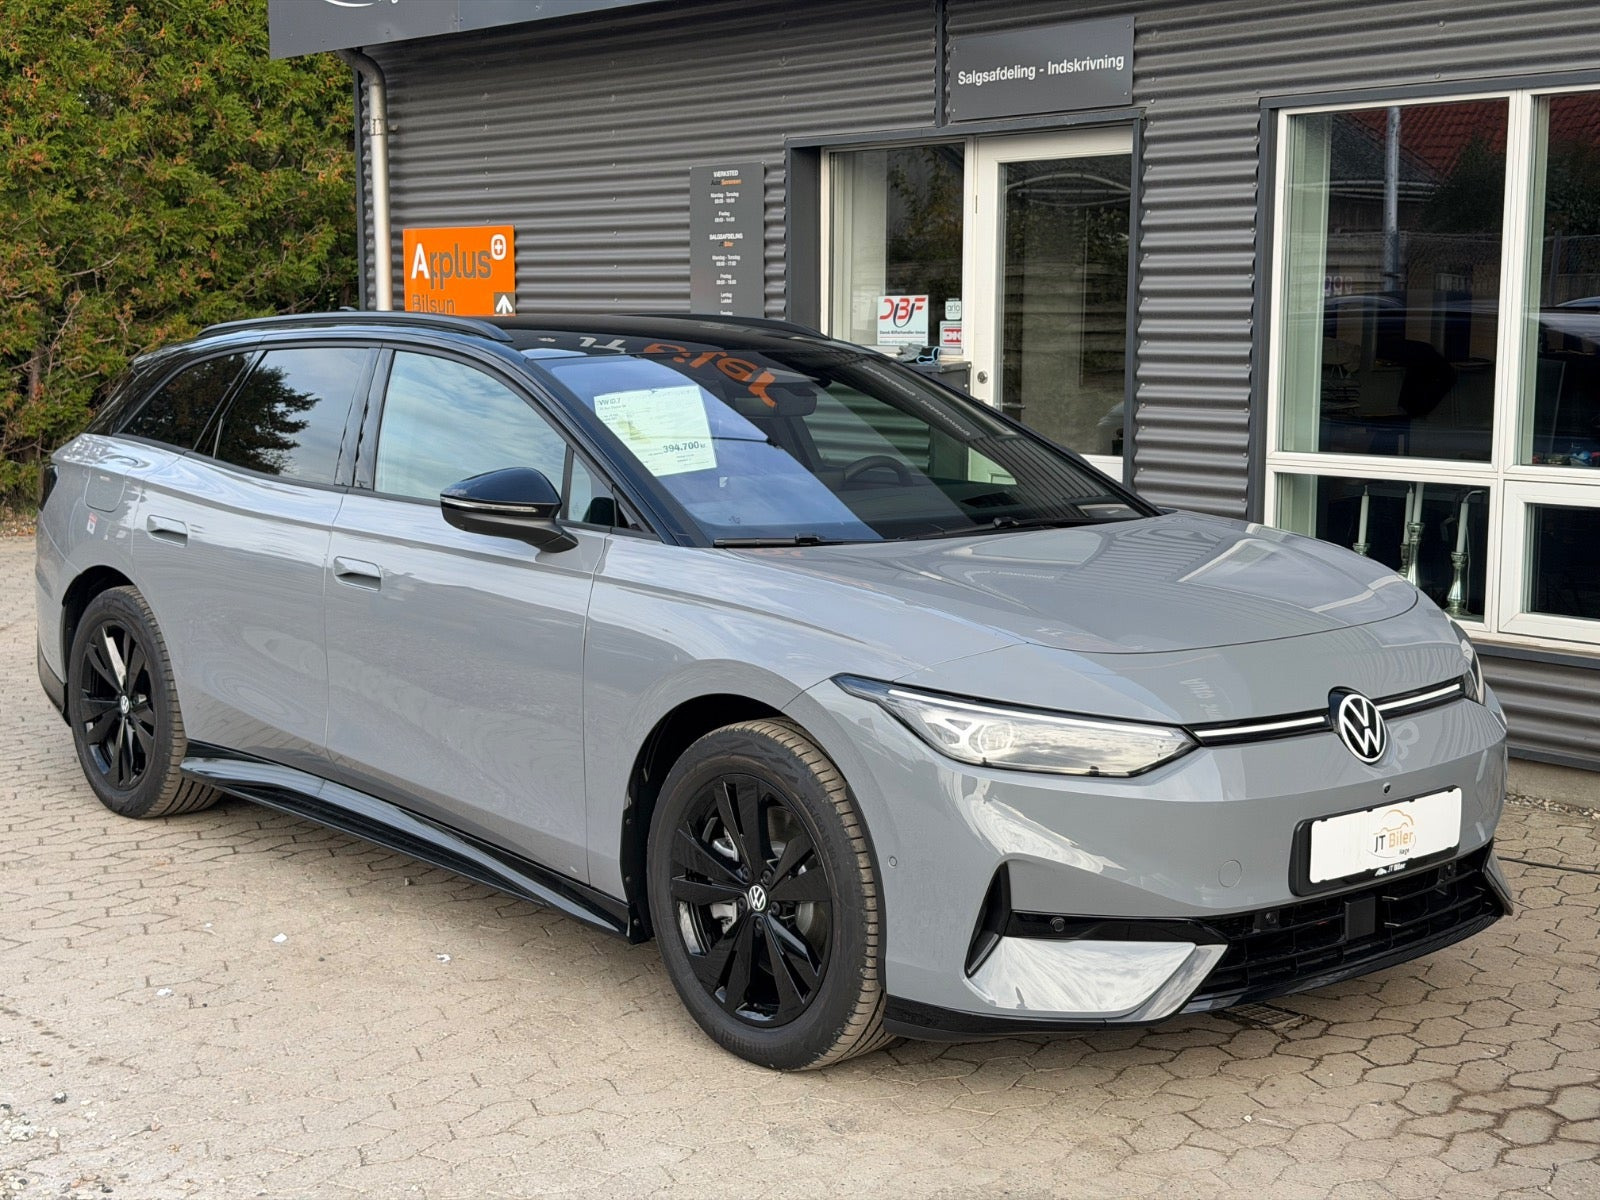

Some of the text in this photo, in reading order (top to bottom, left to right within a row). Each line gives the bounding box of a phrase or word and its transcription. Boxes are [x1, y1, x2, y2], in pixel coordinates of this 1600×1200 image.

[958, 65, 1036, 86] Salgsafdeling
[1047, 55, 1125, 76] Indskrivning
[663, 440, 700, 454] 394.700
[1374, 830, 1414, 853] JT Biler
